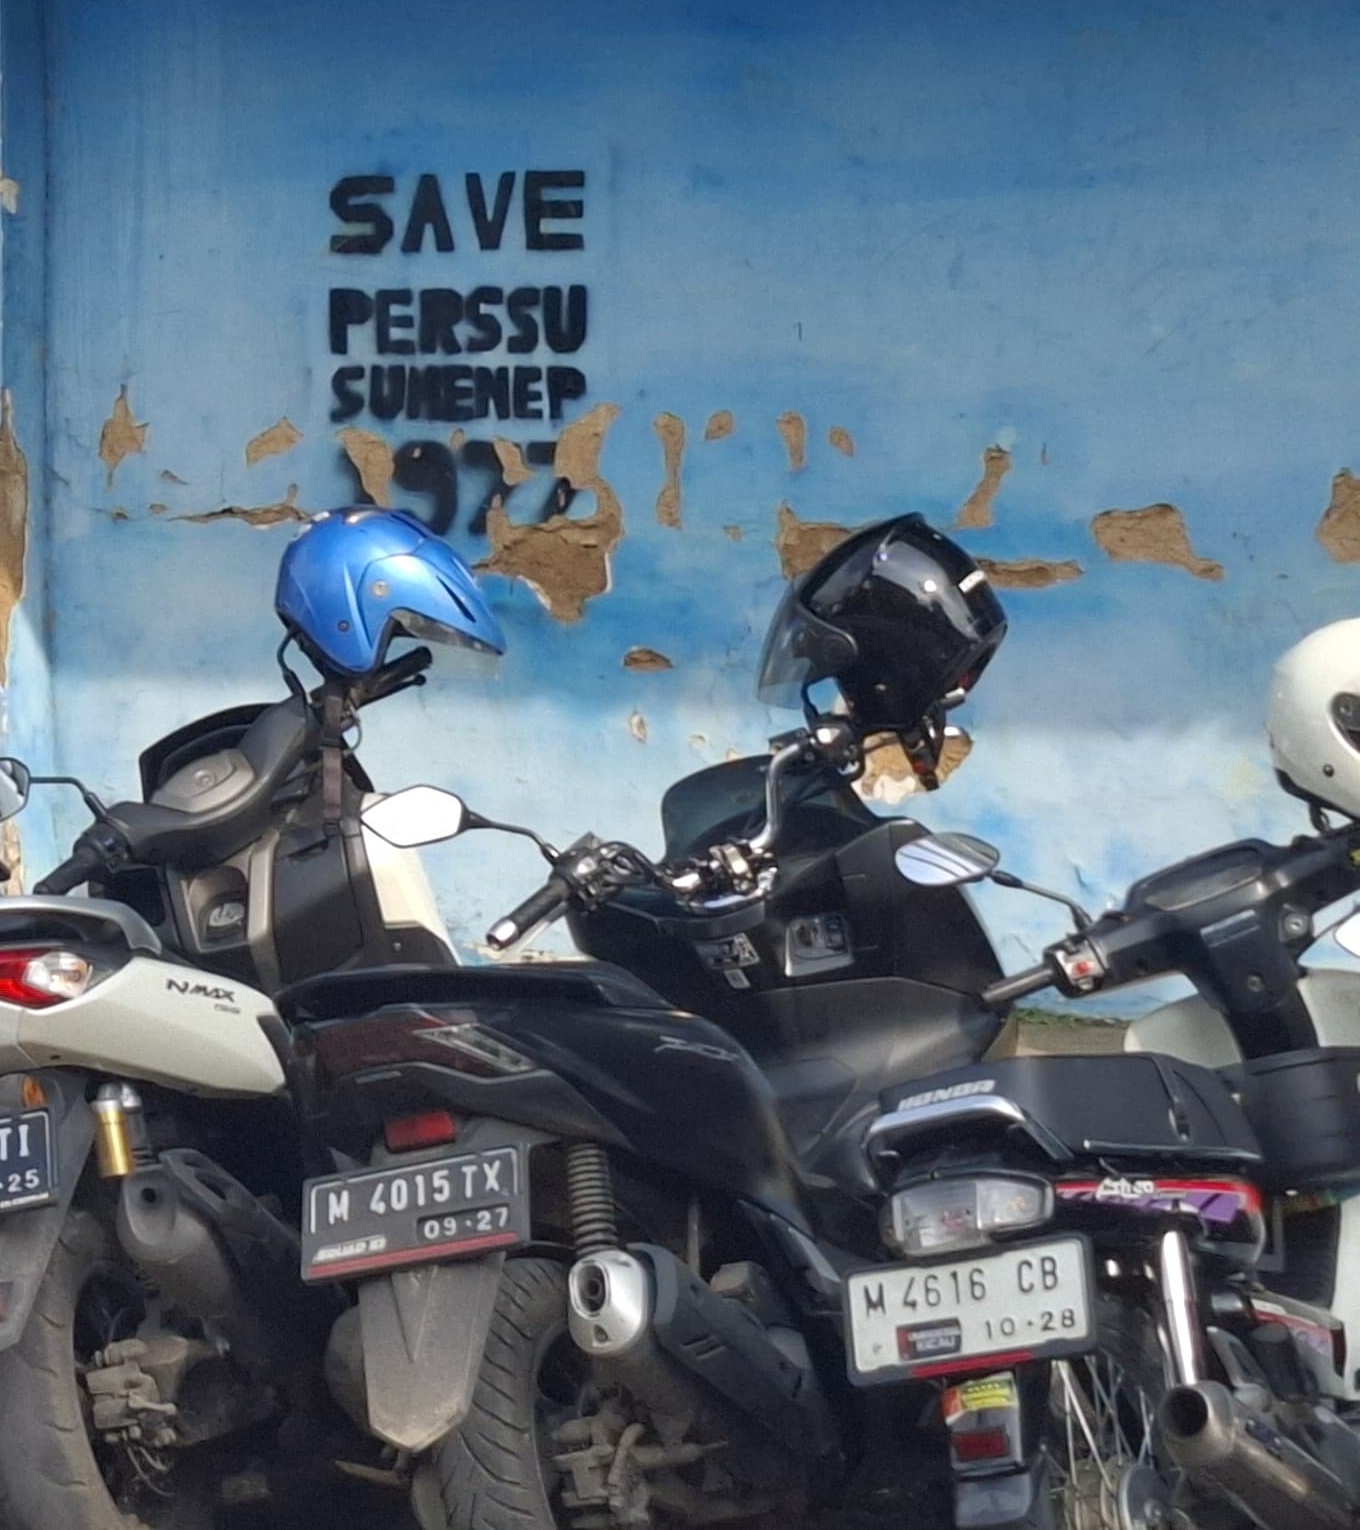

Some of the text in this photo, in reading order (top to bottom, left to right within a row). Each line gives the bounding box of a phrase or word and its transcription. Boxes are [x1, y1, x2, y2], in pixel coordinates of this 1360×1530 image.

[329, 170, 585, 255] SAVE
[328, 284, 588, 355] PERSSU
[329, 364, 587, 422] SUMENEP
[328, 1159, 502, 1225] M 4015 TX
[863, 1255, 1059, 1318] M 4616 CB
